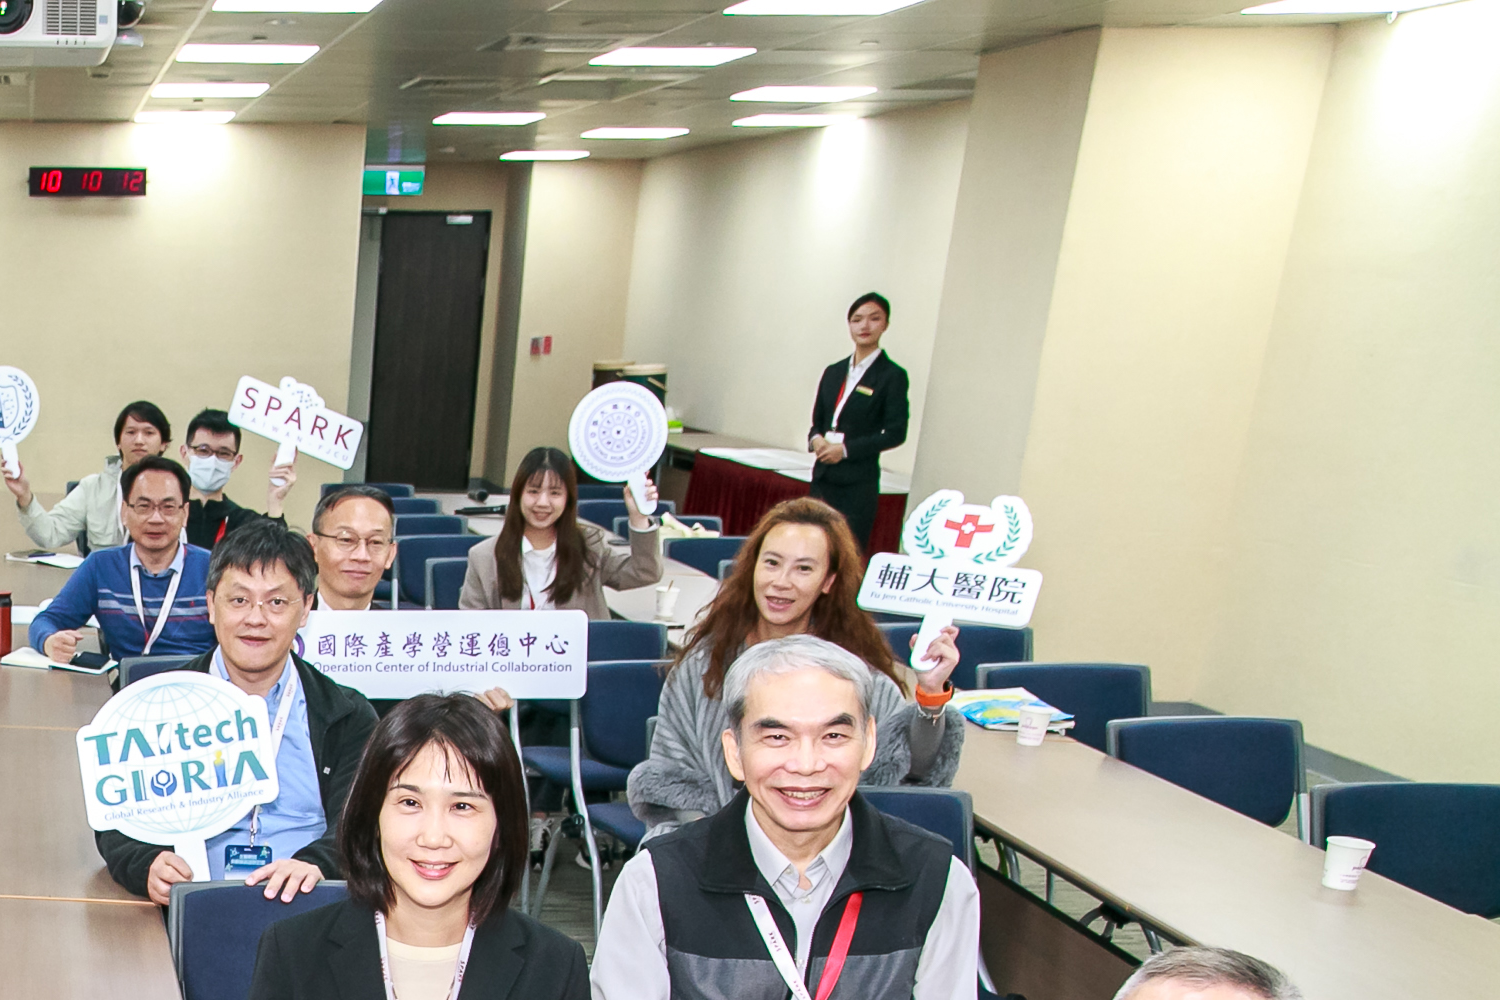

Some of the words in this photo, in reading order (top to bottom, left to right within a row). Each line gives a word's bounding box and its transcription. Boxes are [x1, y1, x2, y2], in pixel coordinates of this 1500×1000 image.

[40, 169, 63, 193] 10
[81, 170, 103, 192] 10
[122, 170, 144, 192] 12
[241, 387, 354, 451] SPARK
[875, 562, 1027, 605] 輔大醫院
[936, 600, 979, 612] University
[981, 605, 1019, 616] Hospital
[317, 631, 569, 659] 國際產學營運總中心
[313, 661, 372, 673] Operation
[375, 661, 415, 673] Center
[417, 661, 430, 673] of
[432, 661, 489, 673] Industrial
[491, 661, 573, 673] Collaboration
[104, 810, 135, 822] Global
[136, 803, 176, 816] Research
[179, 801, 186, 809] &
[188, 794, 224, 808] Industry
[227, 788, 264, 801] Alliance
